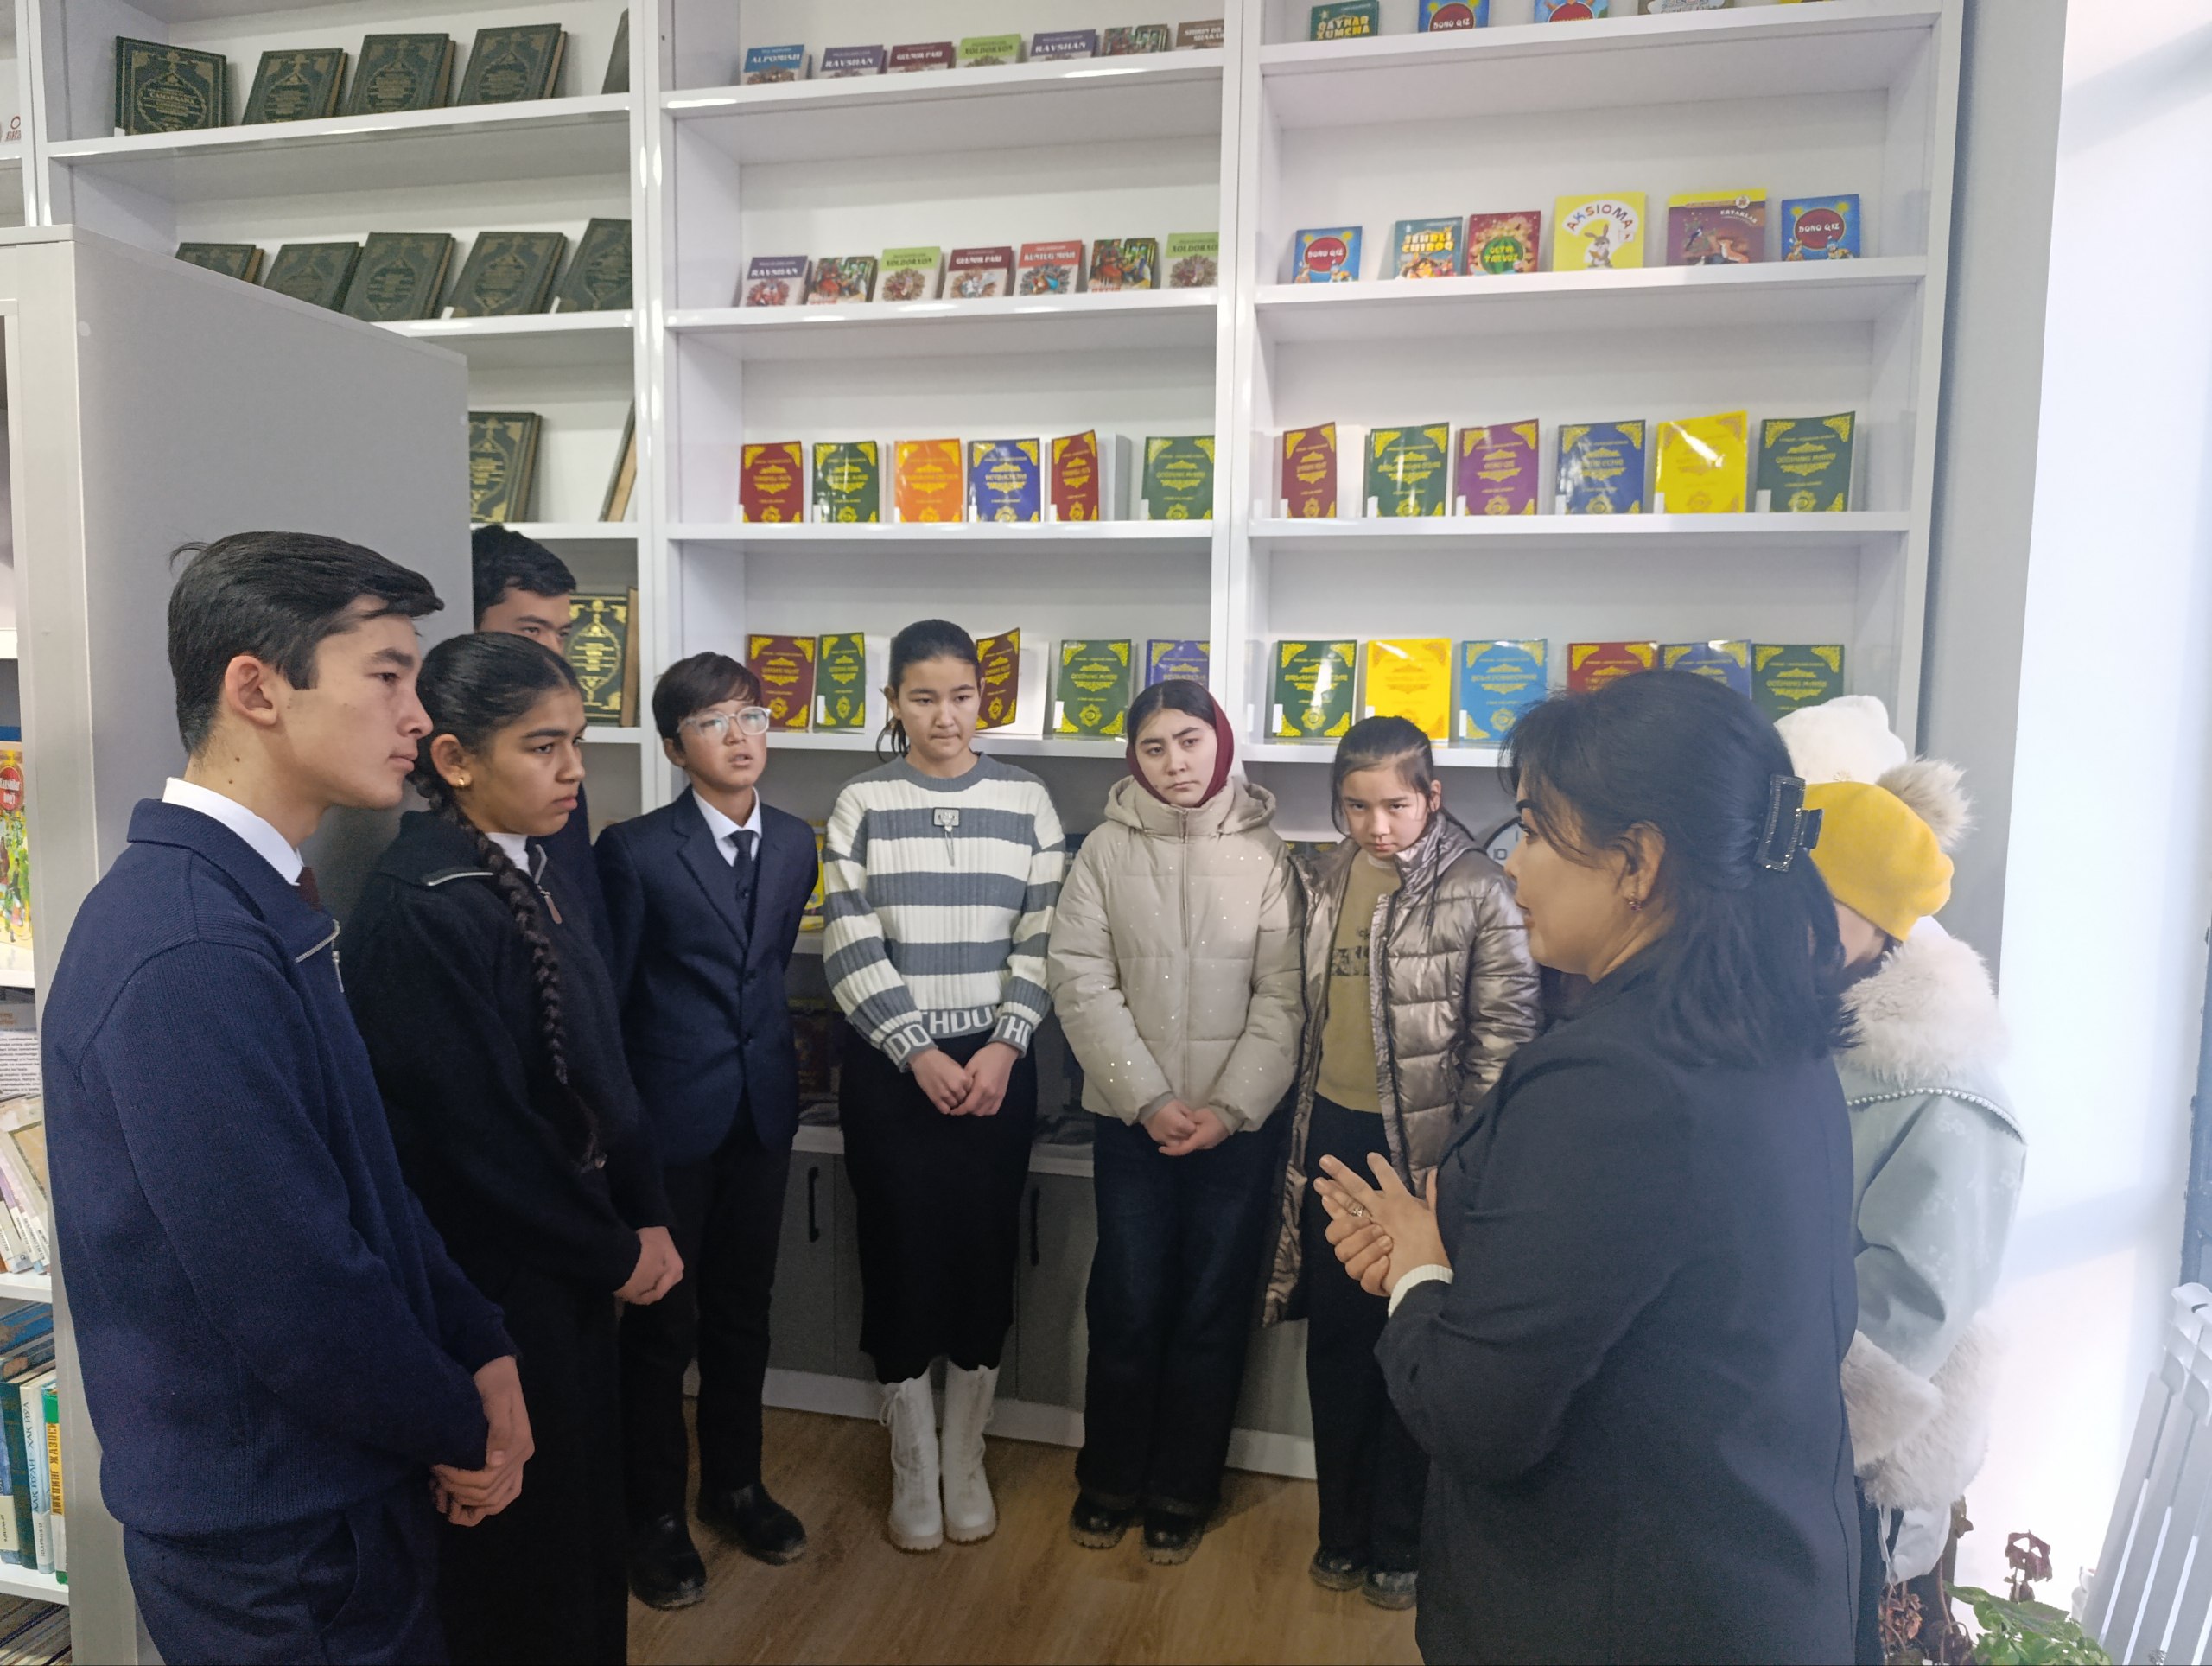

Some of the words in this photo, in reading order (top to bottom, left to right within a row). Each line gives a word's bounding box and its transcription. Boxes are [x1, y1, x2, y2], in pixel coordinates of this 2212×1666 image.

[1433, 19, 1454, 30] DONO
[1456, 17, 1471, 28] QIZ
[1034, 41, 1086, 54] RAVSHAN
[750, 52, 801, 64] ALPOMISH
[824, 57, 874, 69] RAVSHAN
[1566, 201, 1633, 232] AKSIOMA
[1797, 223, 1822, 234] DONO
[1824, 221, 1840, 232] QIZ
